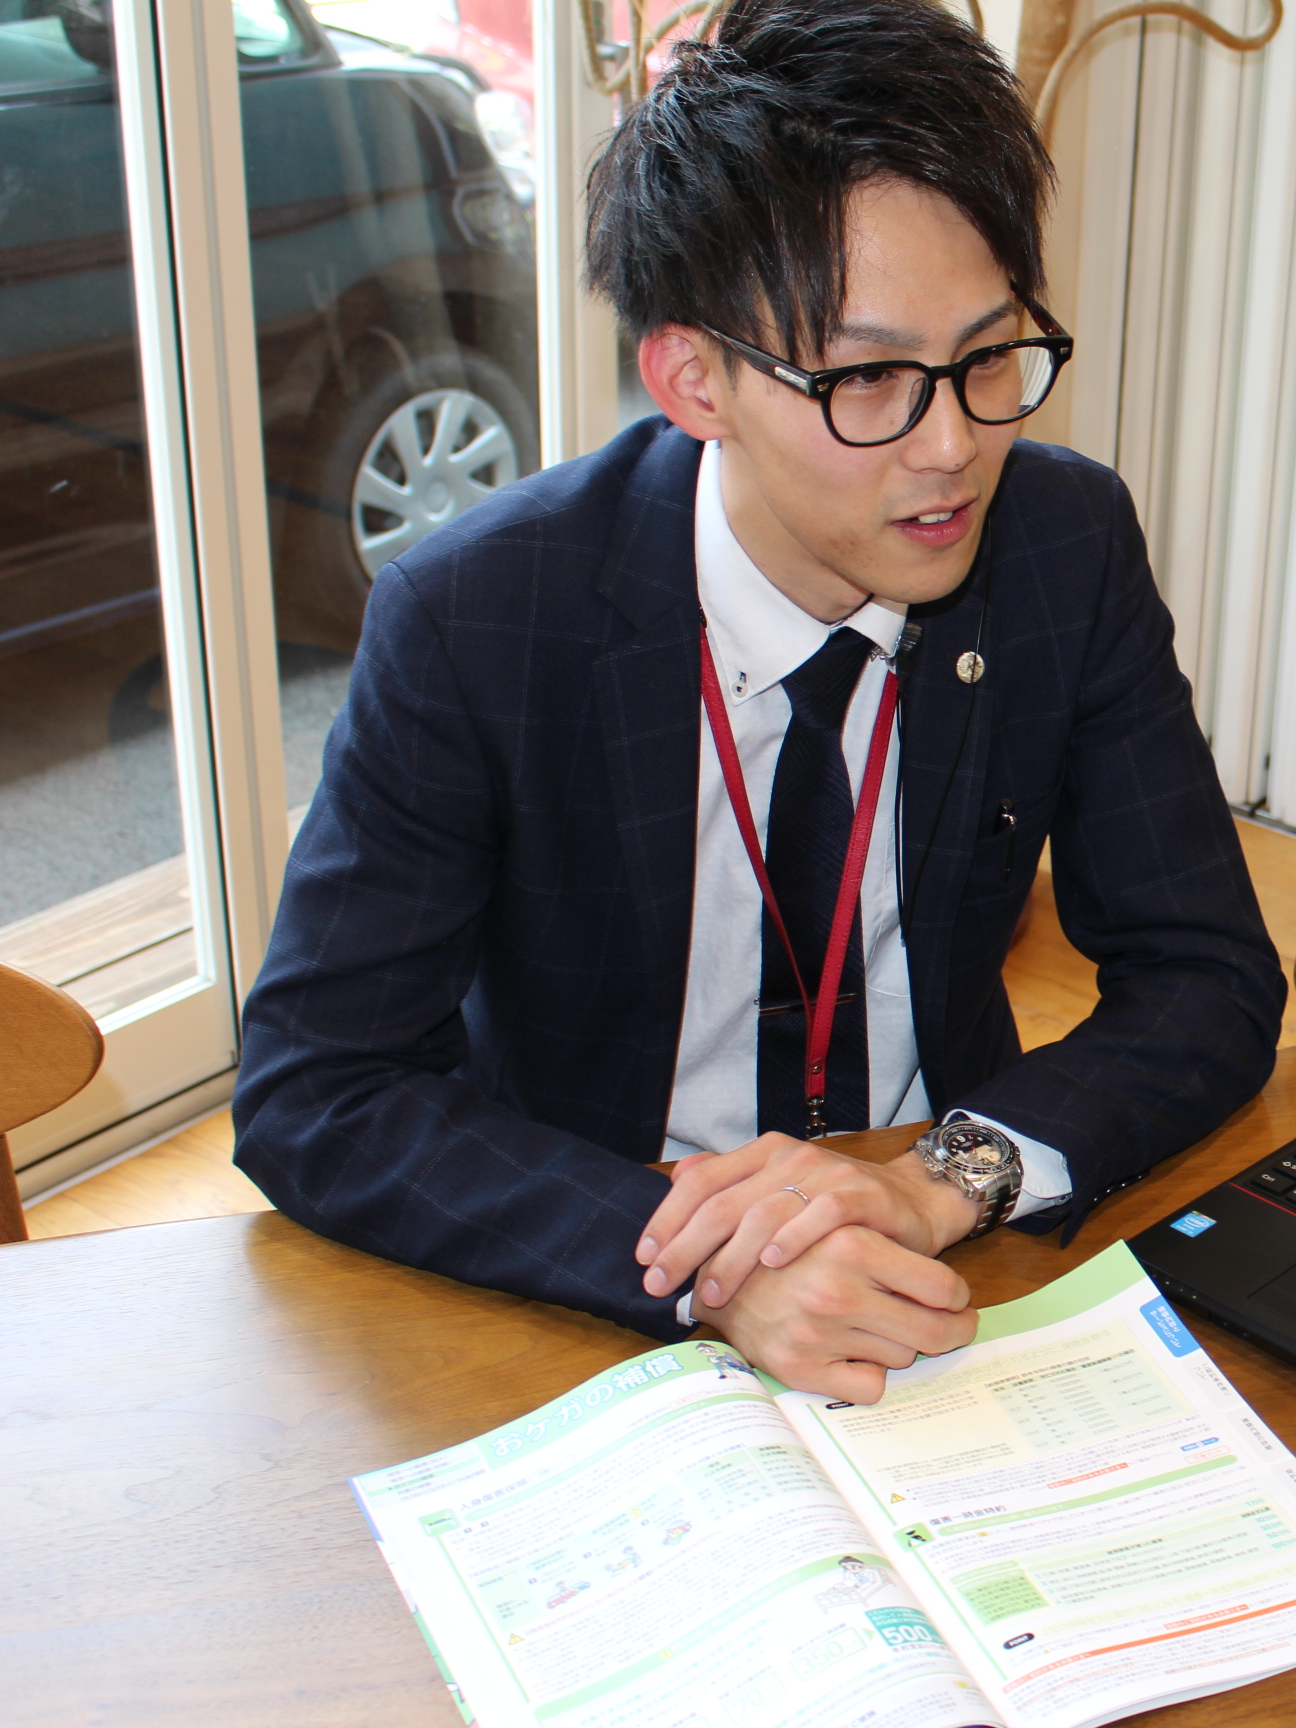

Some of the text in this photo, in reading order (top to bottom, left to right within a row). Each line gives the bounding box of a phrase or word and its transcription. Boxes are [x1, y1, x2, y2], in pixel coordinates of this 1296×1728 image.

[491, 1352, 684, 1457] おケガの補償
[926, 1503, 1008, 1526] 傷害一時金特約
[881, 1625, 932, 1646] 500
[1007, 1635, 1031, 1647] POINT
